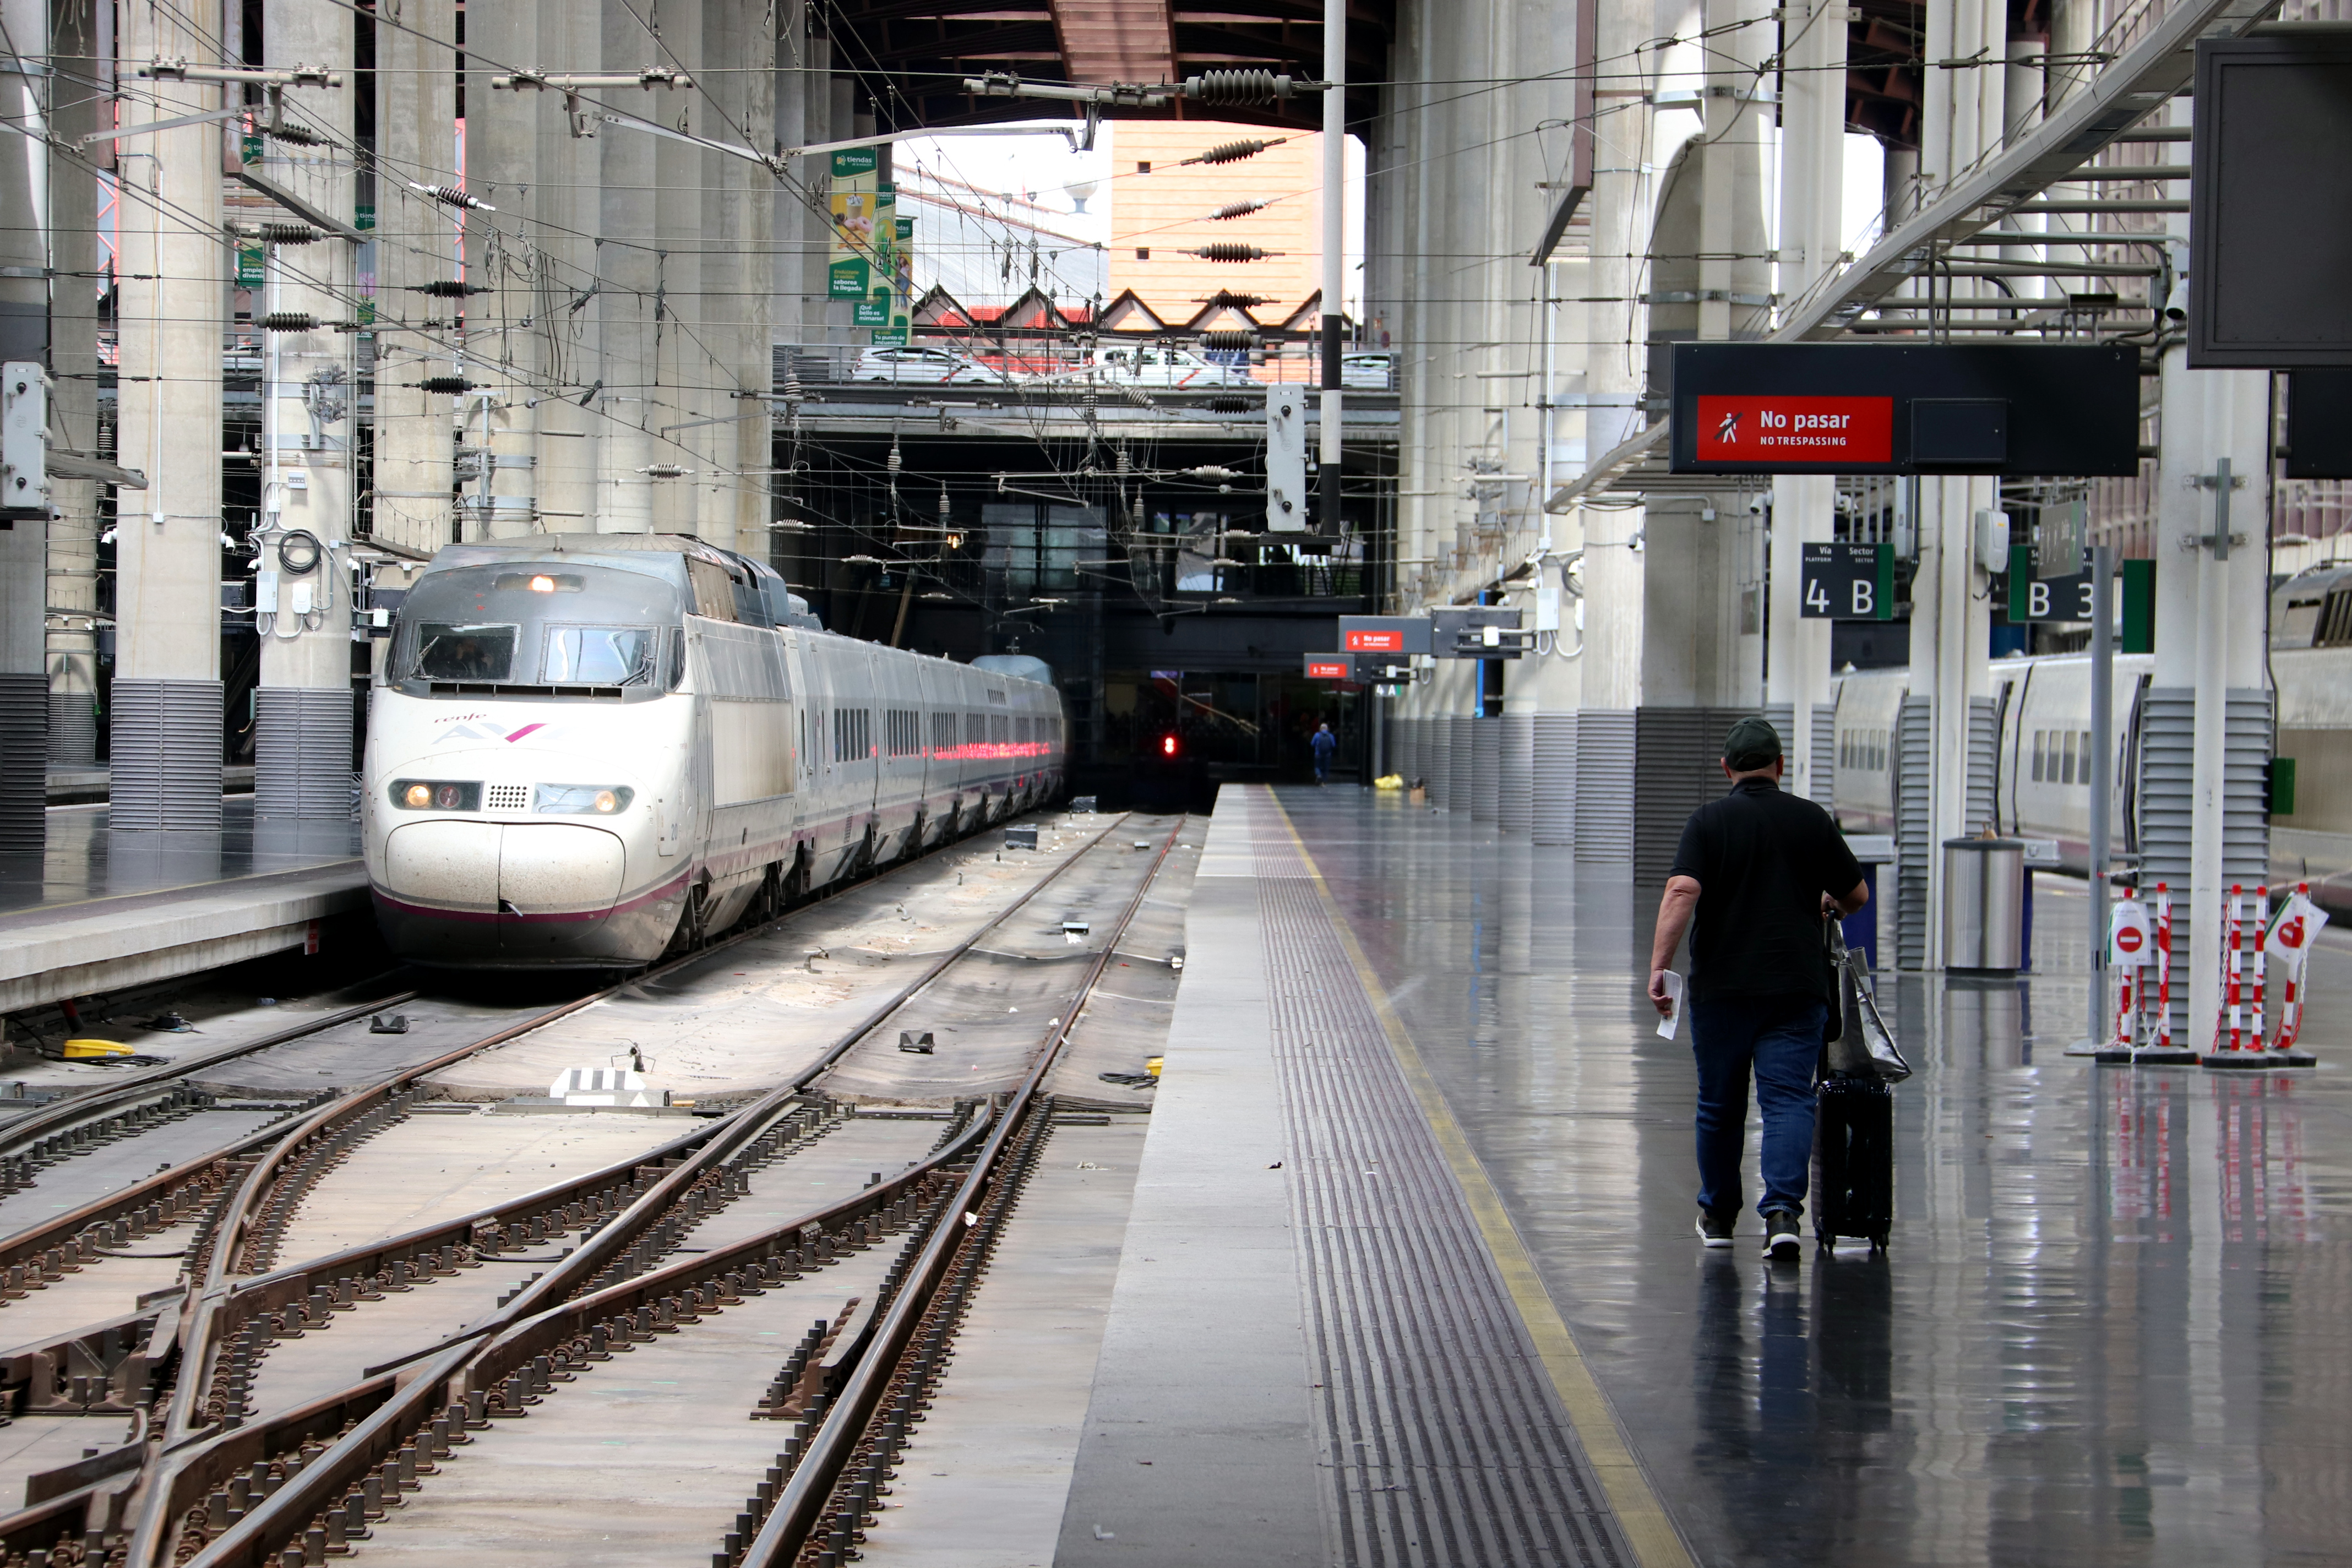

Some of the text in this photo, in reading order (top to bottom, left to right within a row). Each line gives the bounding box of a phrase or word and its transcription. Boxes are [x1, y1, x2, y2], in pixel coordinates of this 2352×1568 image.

[1761, 411, 1850, 432] No pasar
[1760, 436, 1846, 446] NO TRESPASSING
[1819, 546, 1874, 556] Vía Sector
[1806, 579, 1873, 614] 4 B
[2029, 581, 2093, 618] B 3
[1376, 684, 1396, 695] 4 A
[434, 712, 487, 723] renfe
[671, 823, 678, 841] 20
